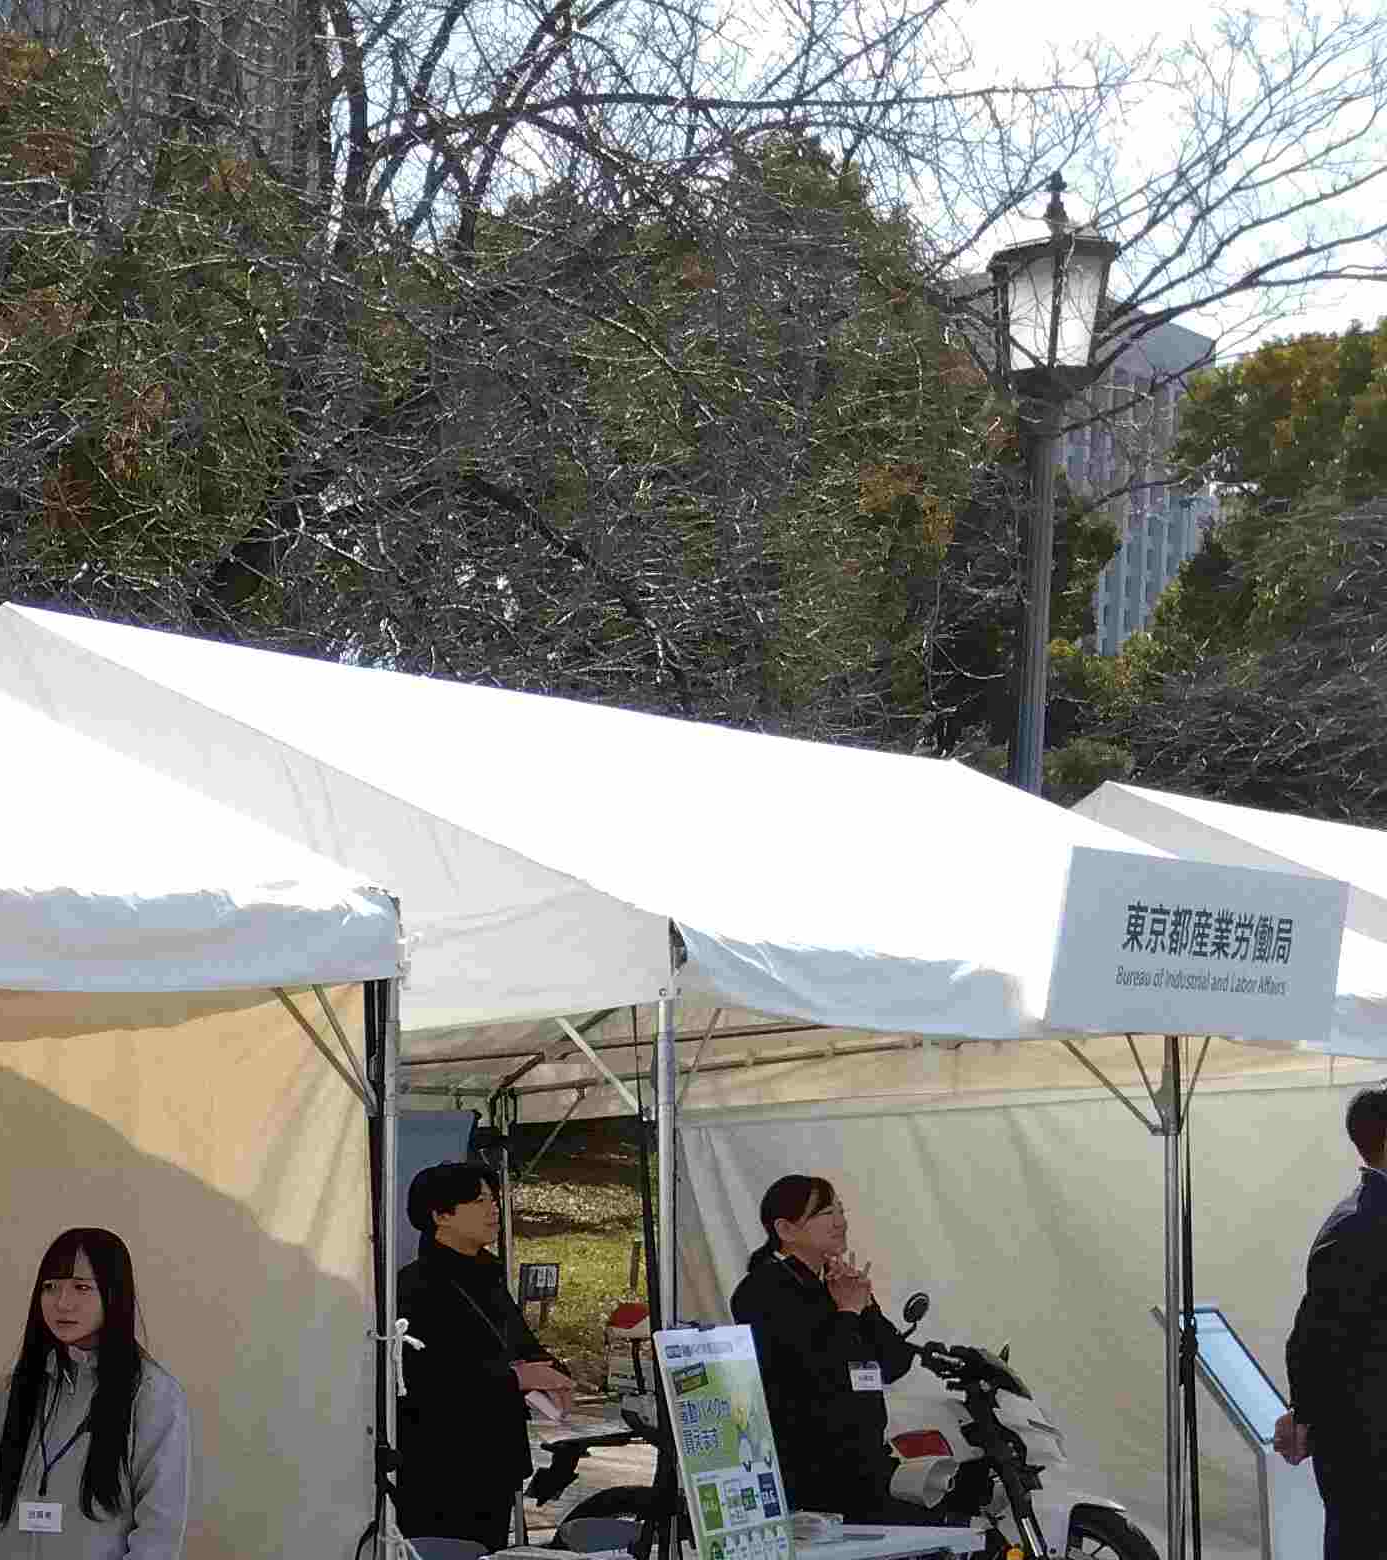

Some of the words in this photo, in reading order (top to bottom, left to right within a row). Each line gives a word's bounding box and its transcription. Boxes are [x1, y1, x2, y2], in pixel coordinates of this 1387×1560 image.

[1122, 901, 1293, 966] 東京都産業労働局
